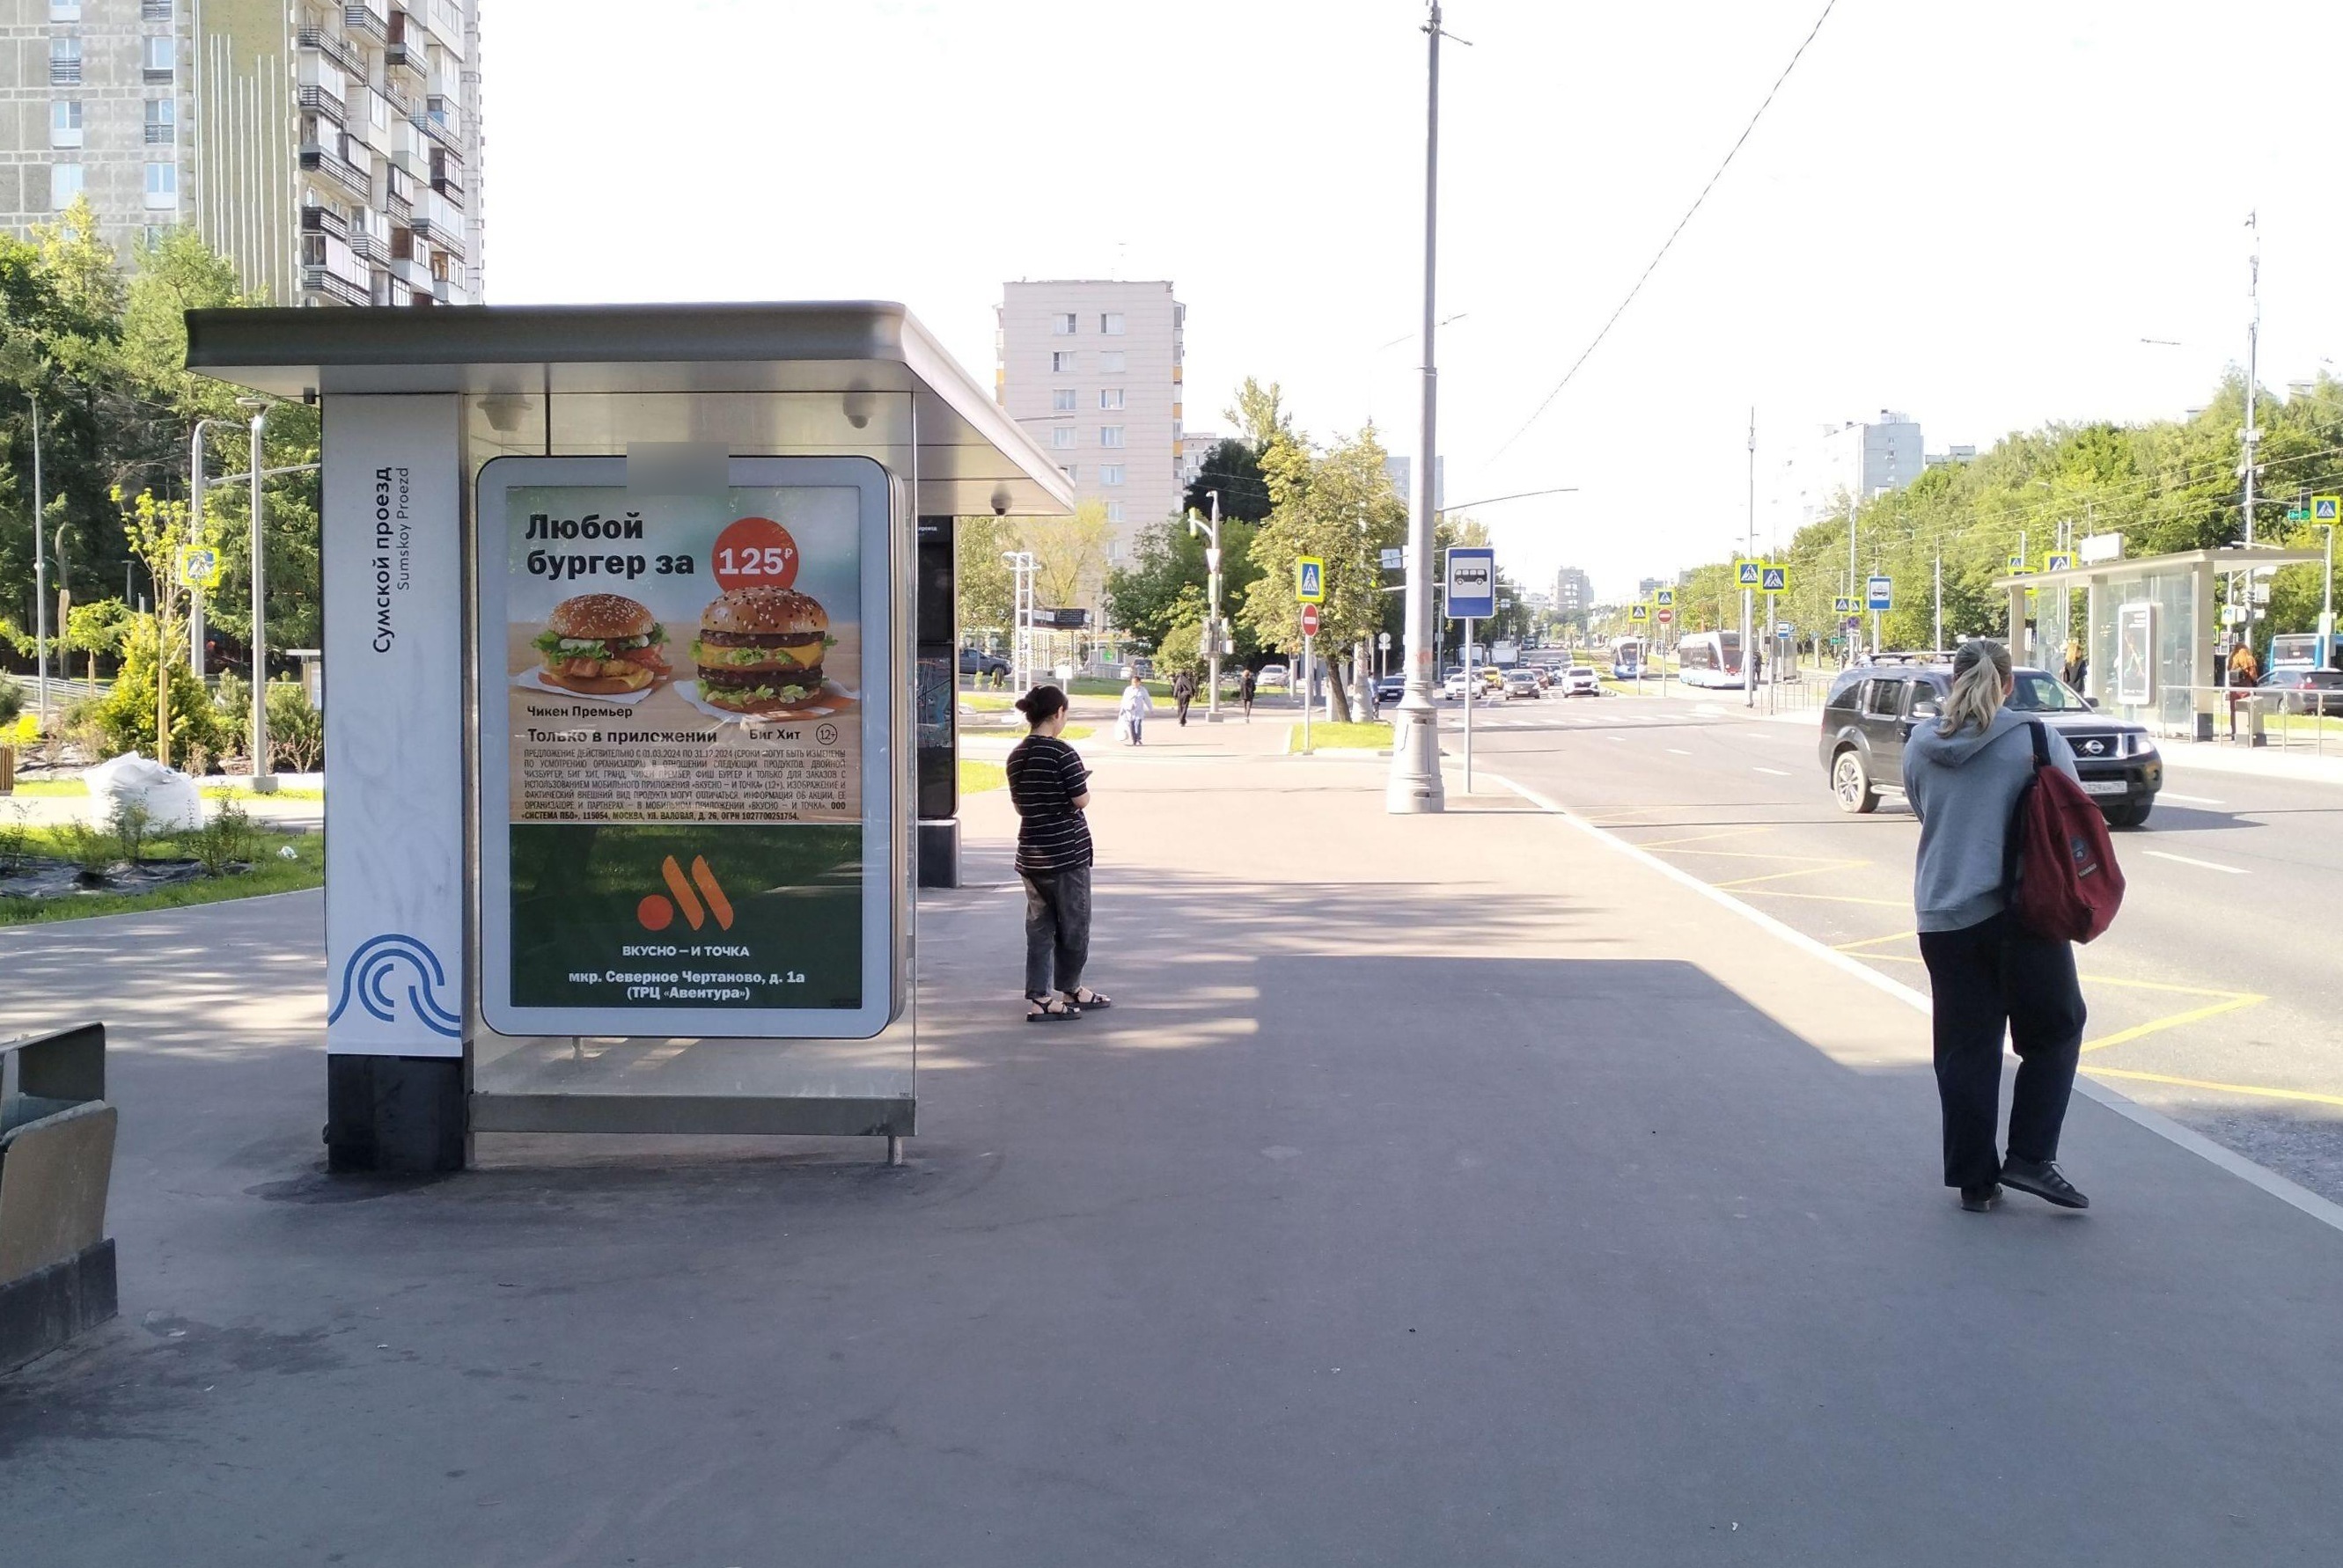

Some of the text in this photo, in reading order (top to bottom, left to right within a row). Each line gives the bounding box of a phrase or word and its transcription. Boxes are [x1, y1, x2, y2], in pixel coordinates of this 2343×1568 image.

[396, 467, 412, 590] Sumskoy Proezd
[525, 511, 643, 539] Любой
[372, 467, 395, 653] Сумской проезд
[526, 549, 694, 581] бургер за
[527, 706, 633, 720] Чикен Премьер
[527, 728, 717, 747] Только в приложении
[749, 729, 801, 741] Биг Хит
[577, 750, 634, 759] ДЕЙСТВИТЕЛЬНО
[787, 771, 802, 780] ДЛЯ
[525, 790, 574, 799] ФАКТИЧЕСКИЙ
[616, 790, 630, 799] ВИД
[634, 790, 667, 799] ПРОДУКТА
[744, 790, 792, 799] ИНФОРМАЦИЯ
[622, 945, 677, 956] ВКУСНО
[691, 946, 701, 956] И
[703, 945, 750, 956] ТОЧКА
[569, 971, 805, 985] мкр. Северное Чертаново, д. 1а
[627, 986, 750, 1001] (ТРЦ «Авентура»)
